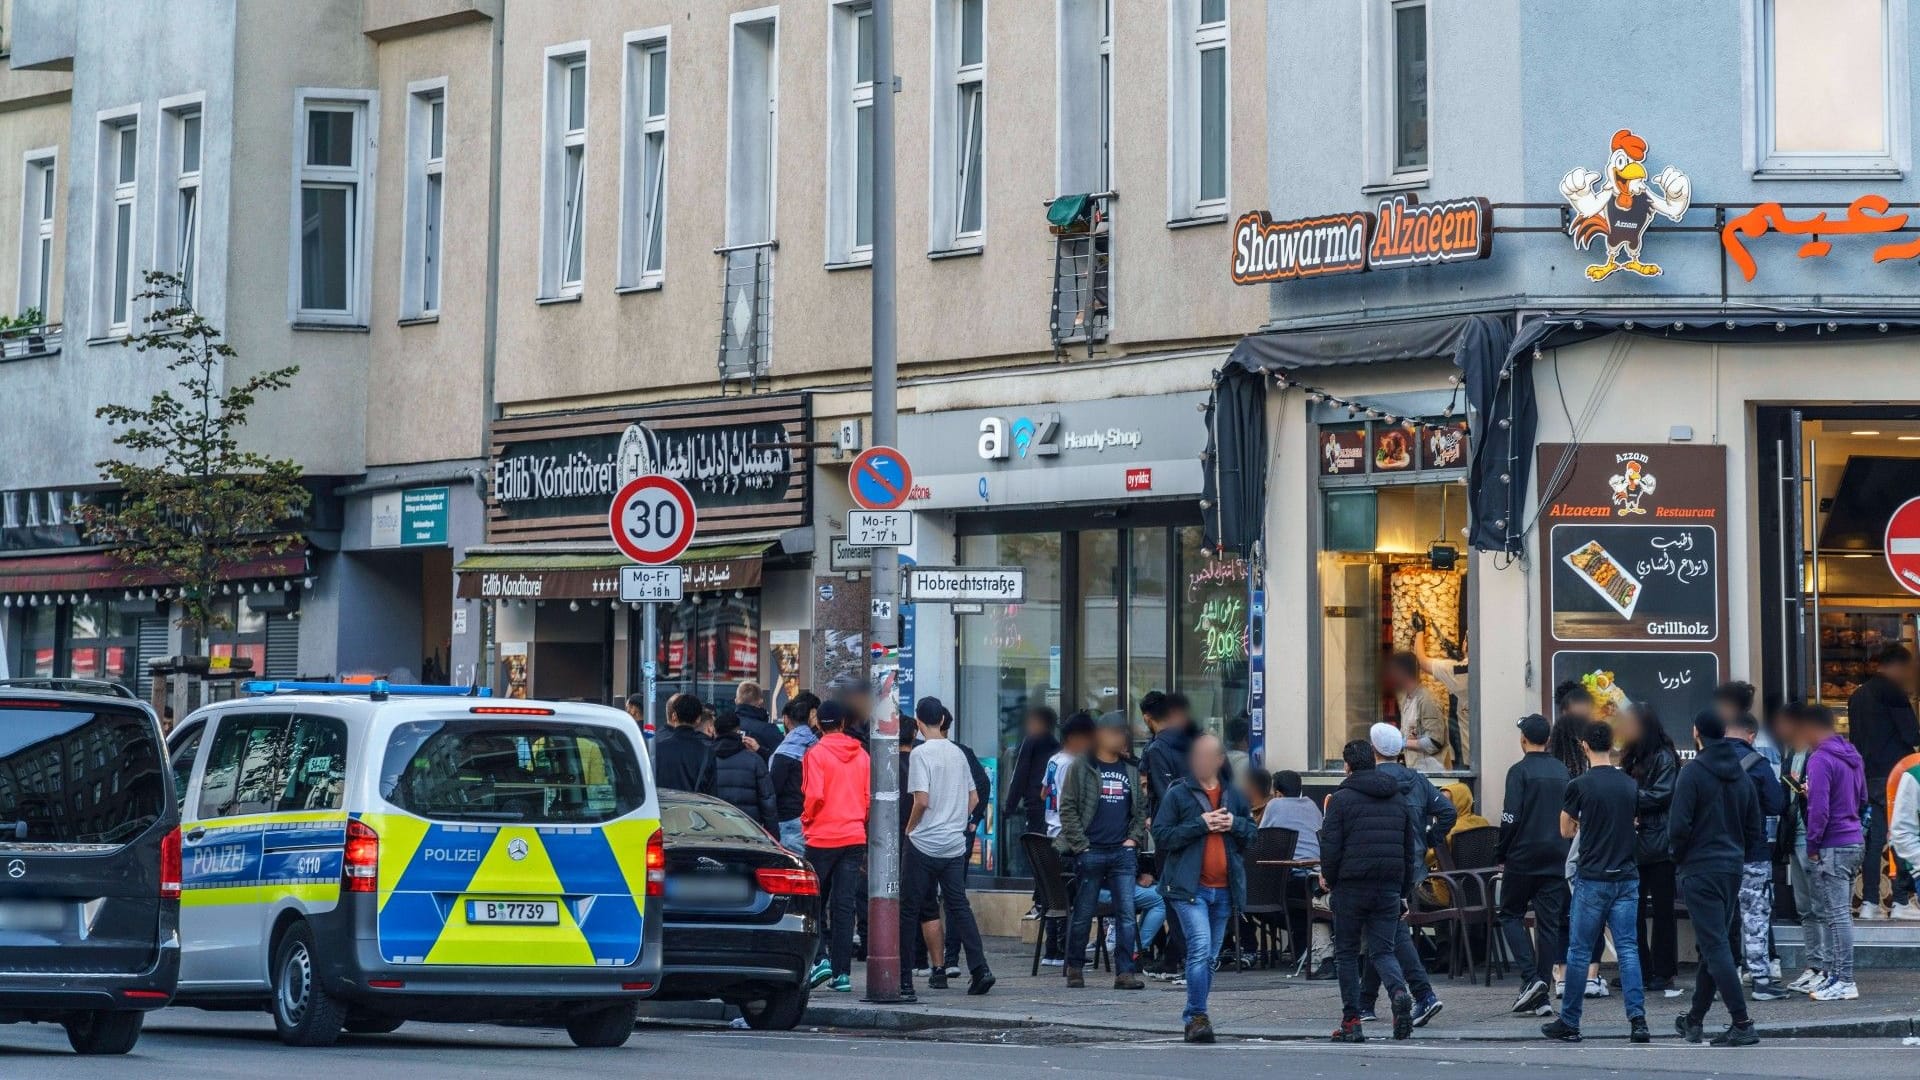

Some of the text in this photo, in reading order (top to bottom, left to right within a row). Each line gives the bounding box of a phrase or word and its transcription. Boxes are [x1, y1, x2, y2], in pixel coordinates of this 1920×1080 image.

[1614, 220, 1638, 229] Azzam
[1235, 204, 1477, 274] Shawarma Alzaeem
[843, 426, 851, 444] 16
[1065, 428, 1142, 453] Handy-Shop
[1616, 452, 1649, 464] Azzam
[494, 452, 617, 500] Edlib Konditorei
[1550, 504, 1716, 518] Alzaeem Restaurant
[629, 500, 676, 539] 30
[862, 516, 898, 526] Mo-Fr
[892, 532, 897, 541] h
[633, 571, 670, 583] Mo-Fr
[918, 574, 1016, 594] Hobrechtstraße
[482, 574, 542, 597] Edlib Konditorei
[664, 586, 670, 597] h
[1647, 622, 1709, 635] Grillholz
[1658, 669, 1692, 689] شاورما
[193, 844, 246, 874] POLIZEI
[424, 848, 481, 862] POLIZEI
[305, 857, 320, 874] 110
[487, 904, 545, 919] B 7739
